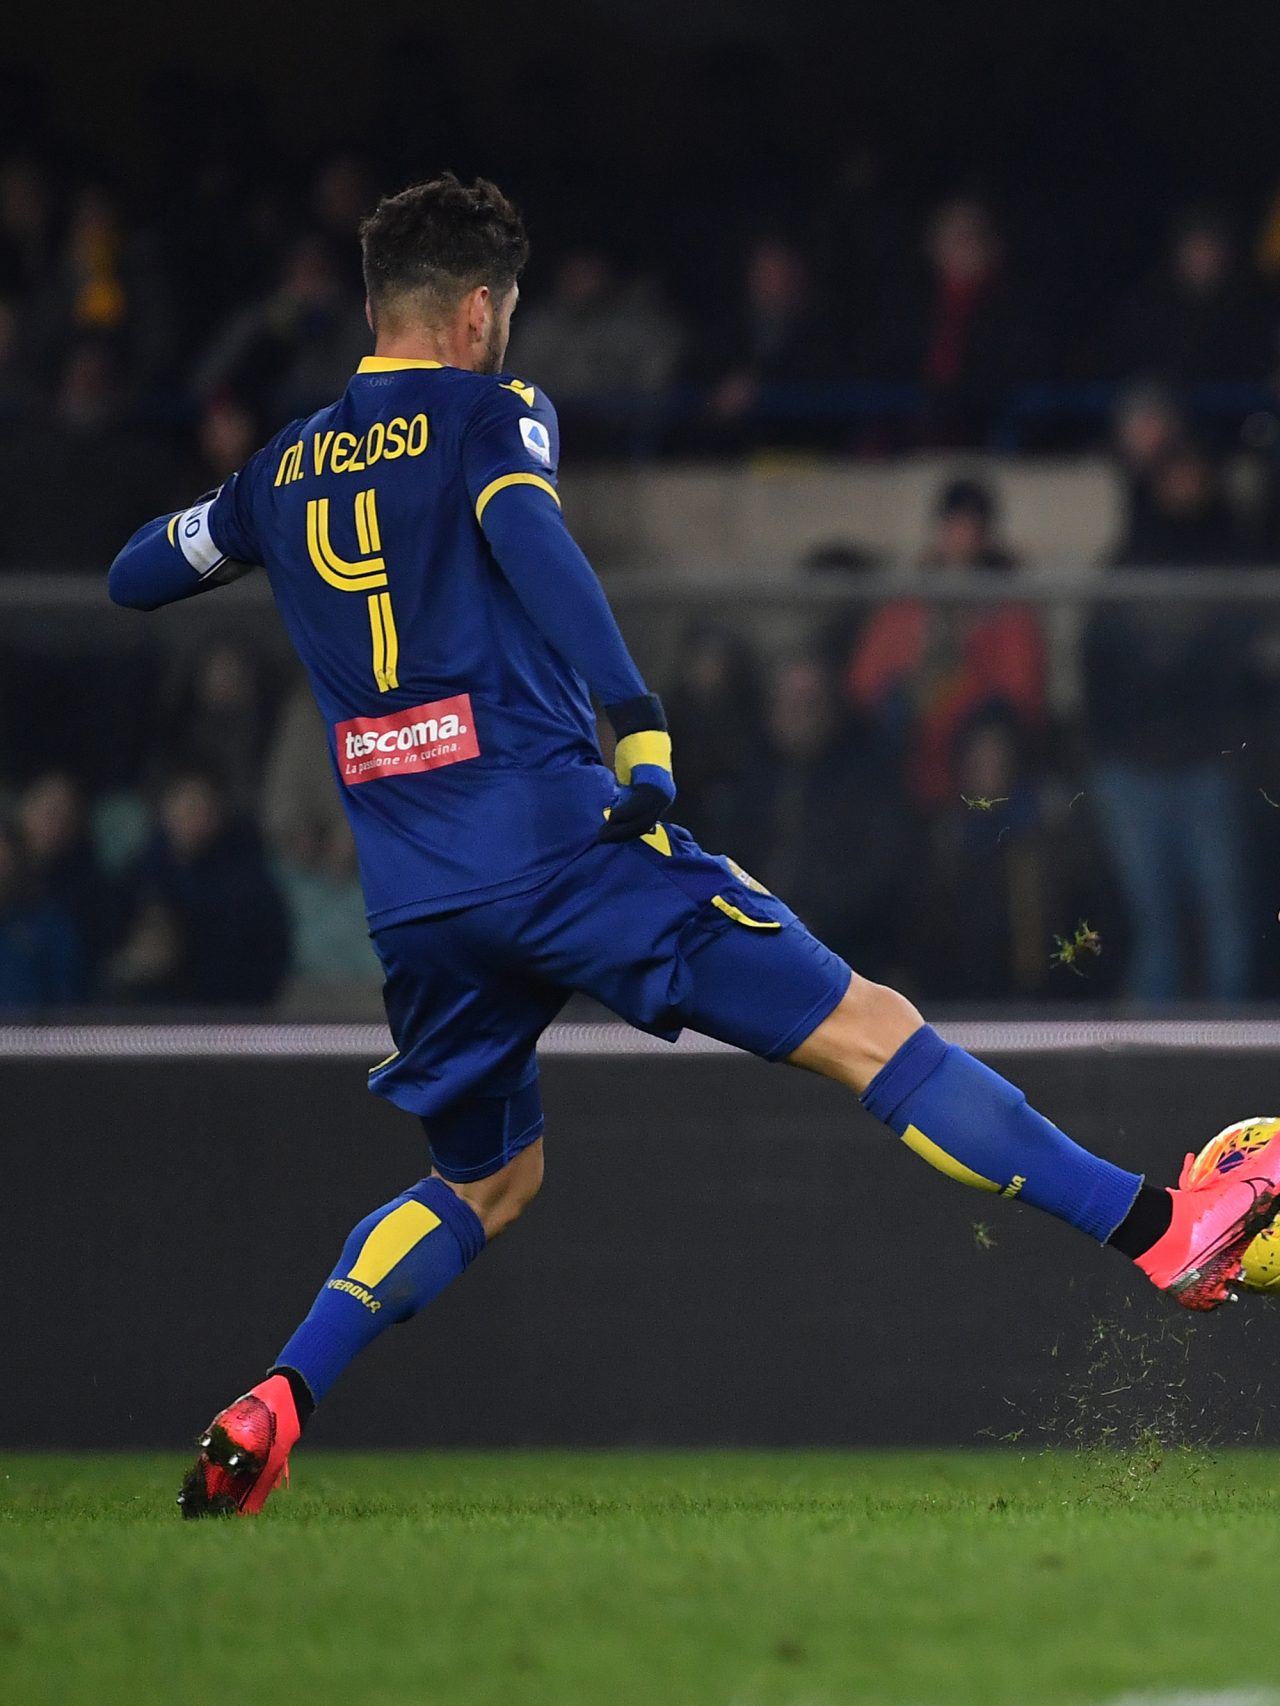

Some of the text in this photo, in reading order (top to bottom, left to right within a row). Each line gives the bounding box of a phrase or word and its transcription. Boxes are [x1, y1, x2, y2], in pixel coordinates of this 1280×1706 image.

[314, 413, 428, 476] VELOSO
[307, 488, 399, 693] 4
[345, 764, 357, 774] La
[404, 752, 418, 764] in
[327, 1279, 382, 1314] VERONA
